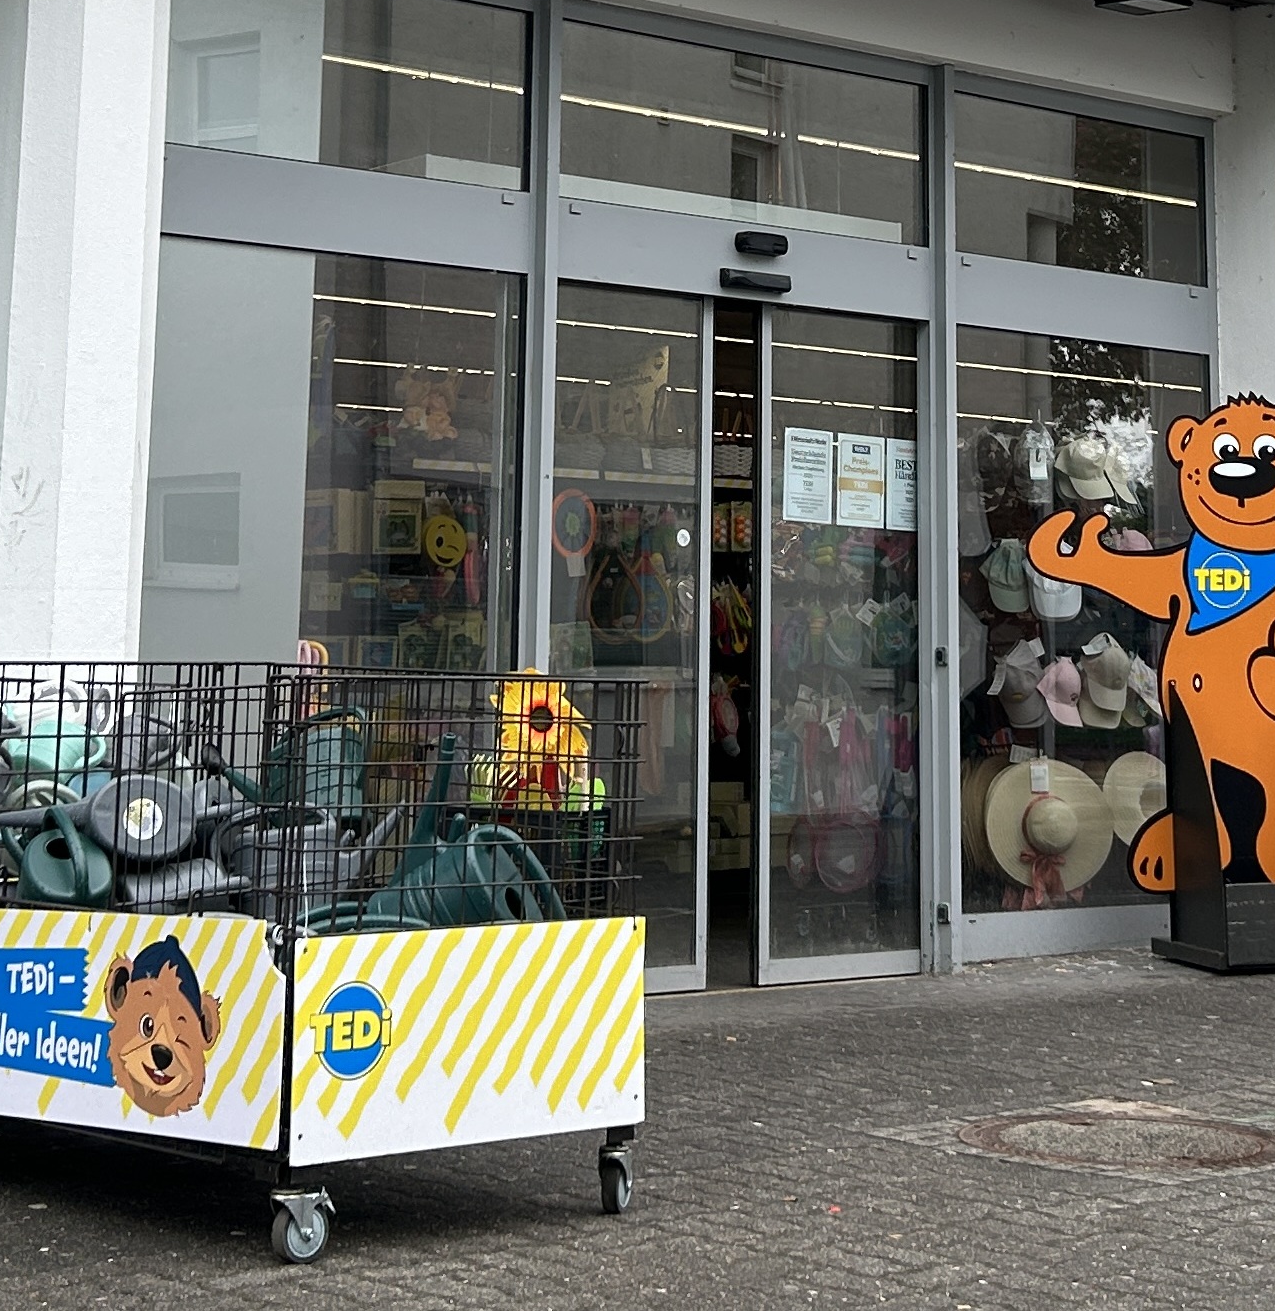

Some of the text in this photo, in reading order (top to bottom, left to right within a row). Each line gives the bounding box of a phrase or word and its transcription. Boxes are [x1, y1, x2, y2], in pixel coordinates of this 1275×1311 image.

[1193, 568, 1252, 592] TEDi
[6, 960, 55, 996] TEDi
[35, 1020, 102, 1074] Ideen!
[309, 1007, 392, 1055] TEDi
